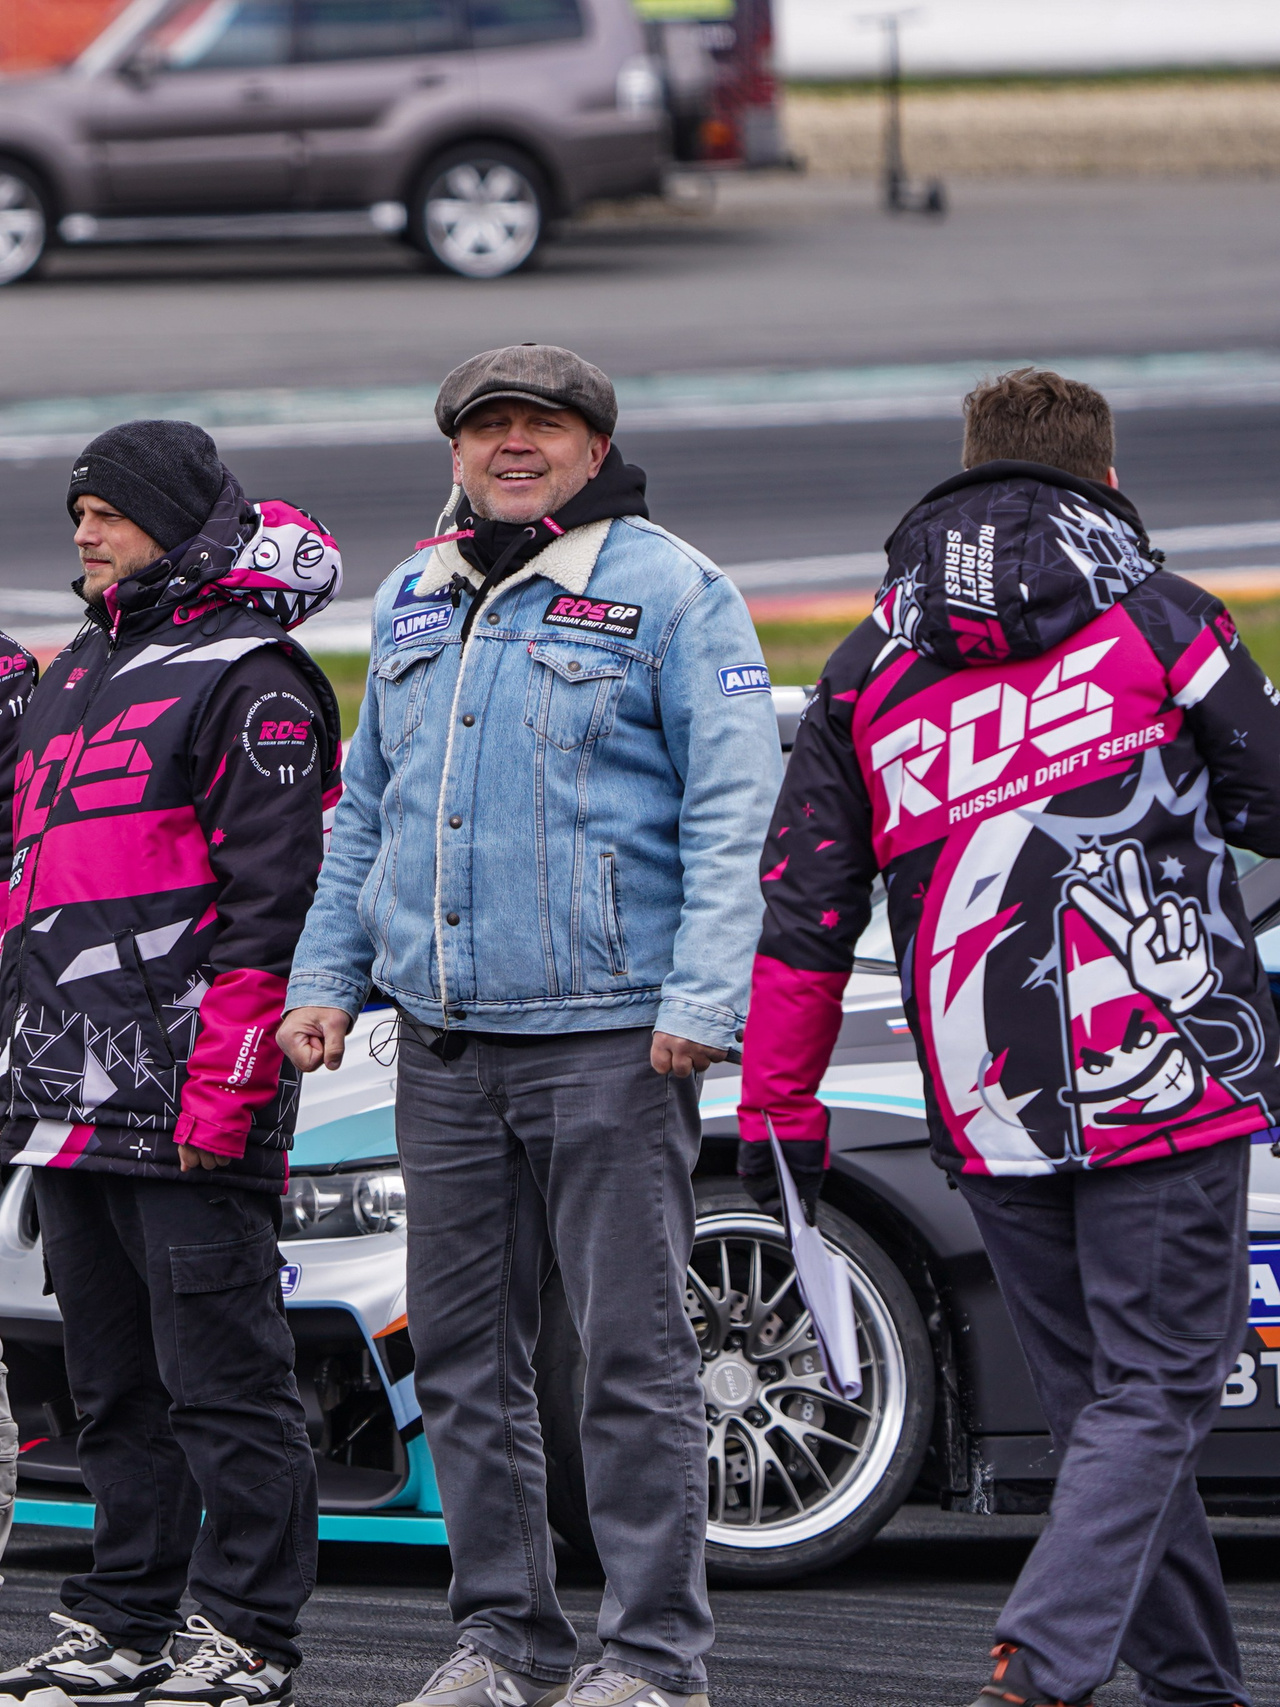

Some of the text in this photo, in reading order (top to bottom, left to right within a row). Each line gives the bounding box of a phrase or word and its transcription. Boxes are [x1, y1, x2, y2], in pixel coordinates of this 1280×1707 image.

[944, 529, 962, 596] SERIES
[961, 543, 977, 601] DRIFT
[977, 524, 996, 606] RUSSIAN
[395, 609, 448, 639] AIMOL
[546, 614, 634, 635] RUSSIAN DRIFT SERIES
[552, 597, 638, 621] RDS GP
[244, 691, 277, 728] OFFICIAL TEAM
[259, 720, 311, 741] RDS
[871, 636, 1120, 834] RDS
[241, 731, 271, 777] OFFICIAL TEAM
[948, 722, 1166, 825] RUSSIAN DRIFT SERIES
[227, 1026, 258, 1085] OFFICIAL
